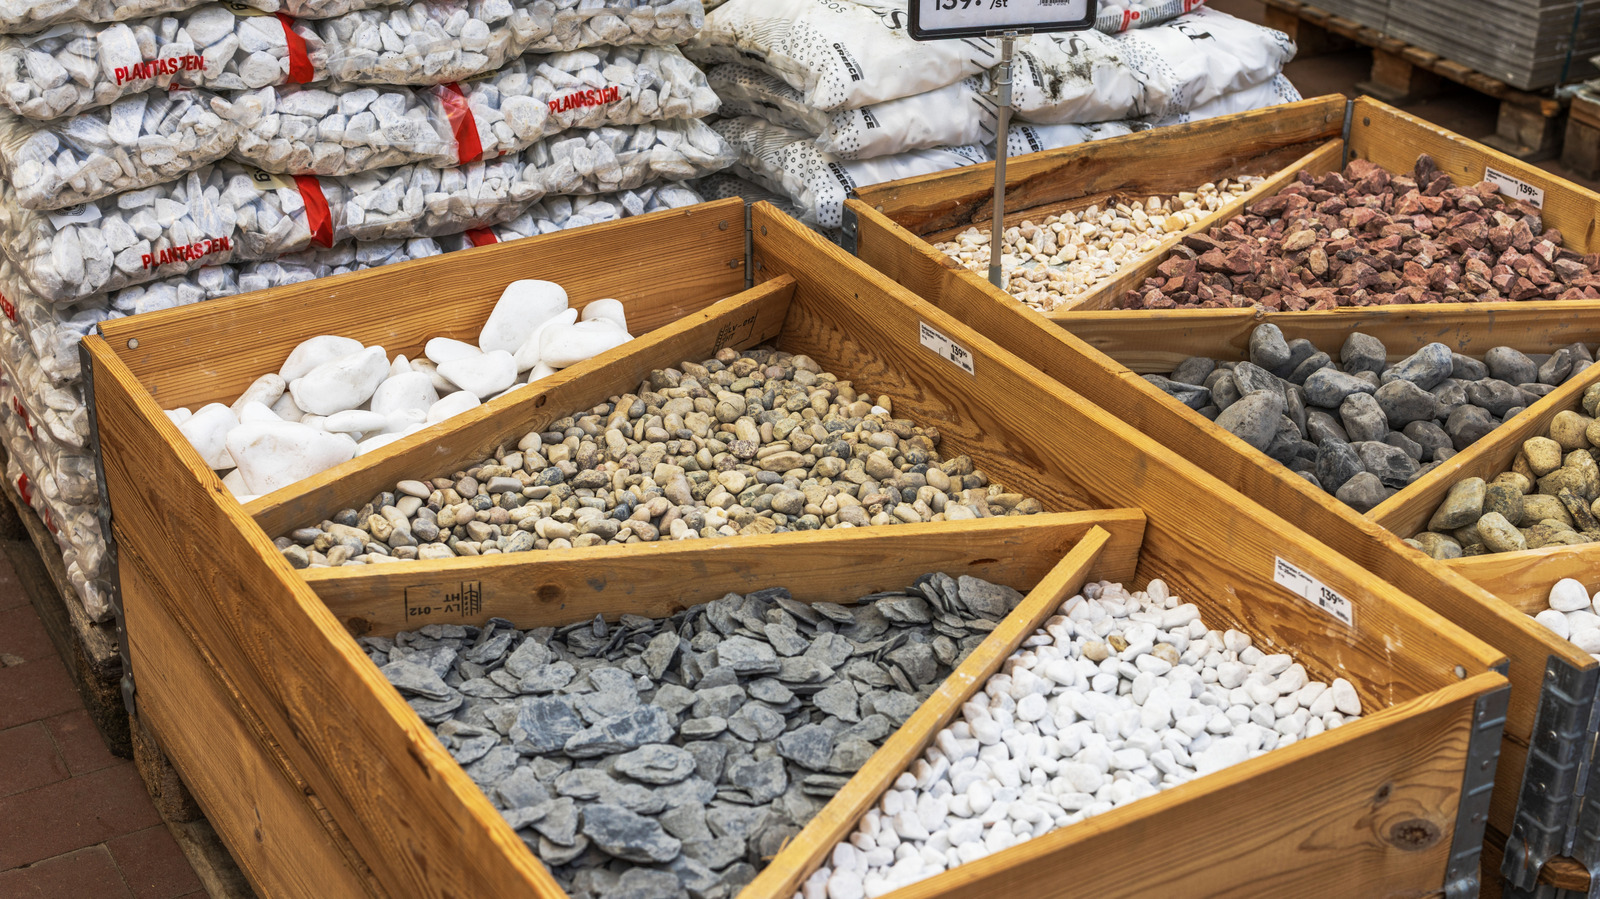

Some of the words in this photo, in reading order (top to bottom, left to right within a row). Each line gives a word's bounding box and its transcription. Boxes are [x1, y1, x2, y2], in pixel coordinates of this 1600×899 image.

[833, 42, 861, 82] GREECE
[1021, 126, 1040, 153] GREE
[443, 593, 460, 602] HT
[1320, 586, 1338, 605] 139
